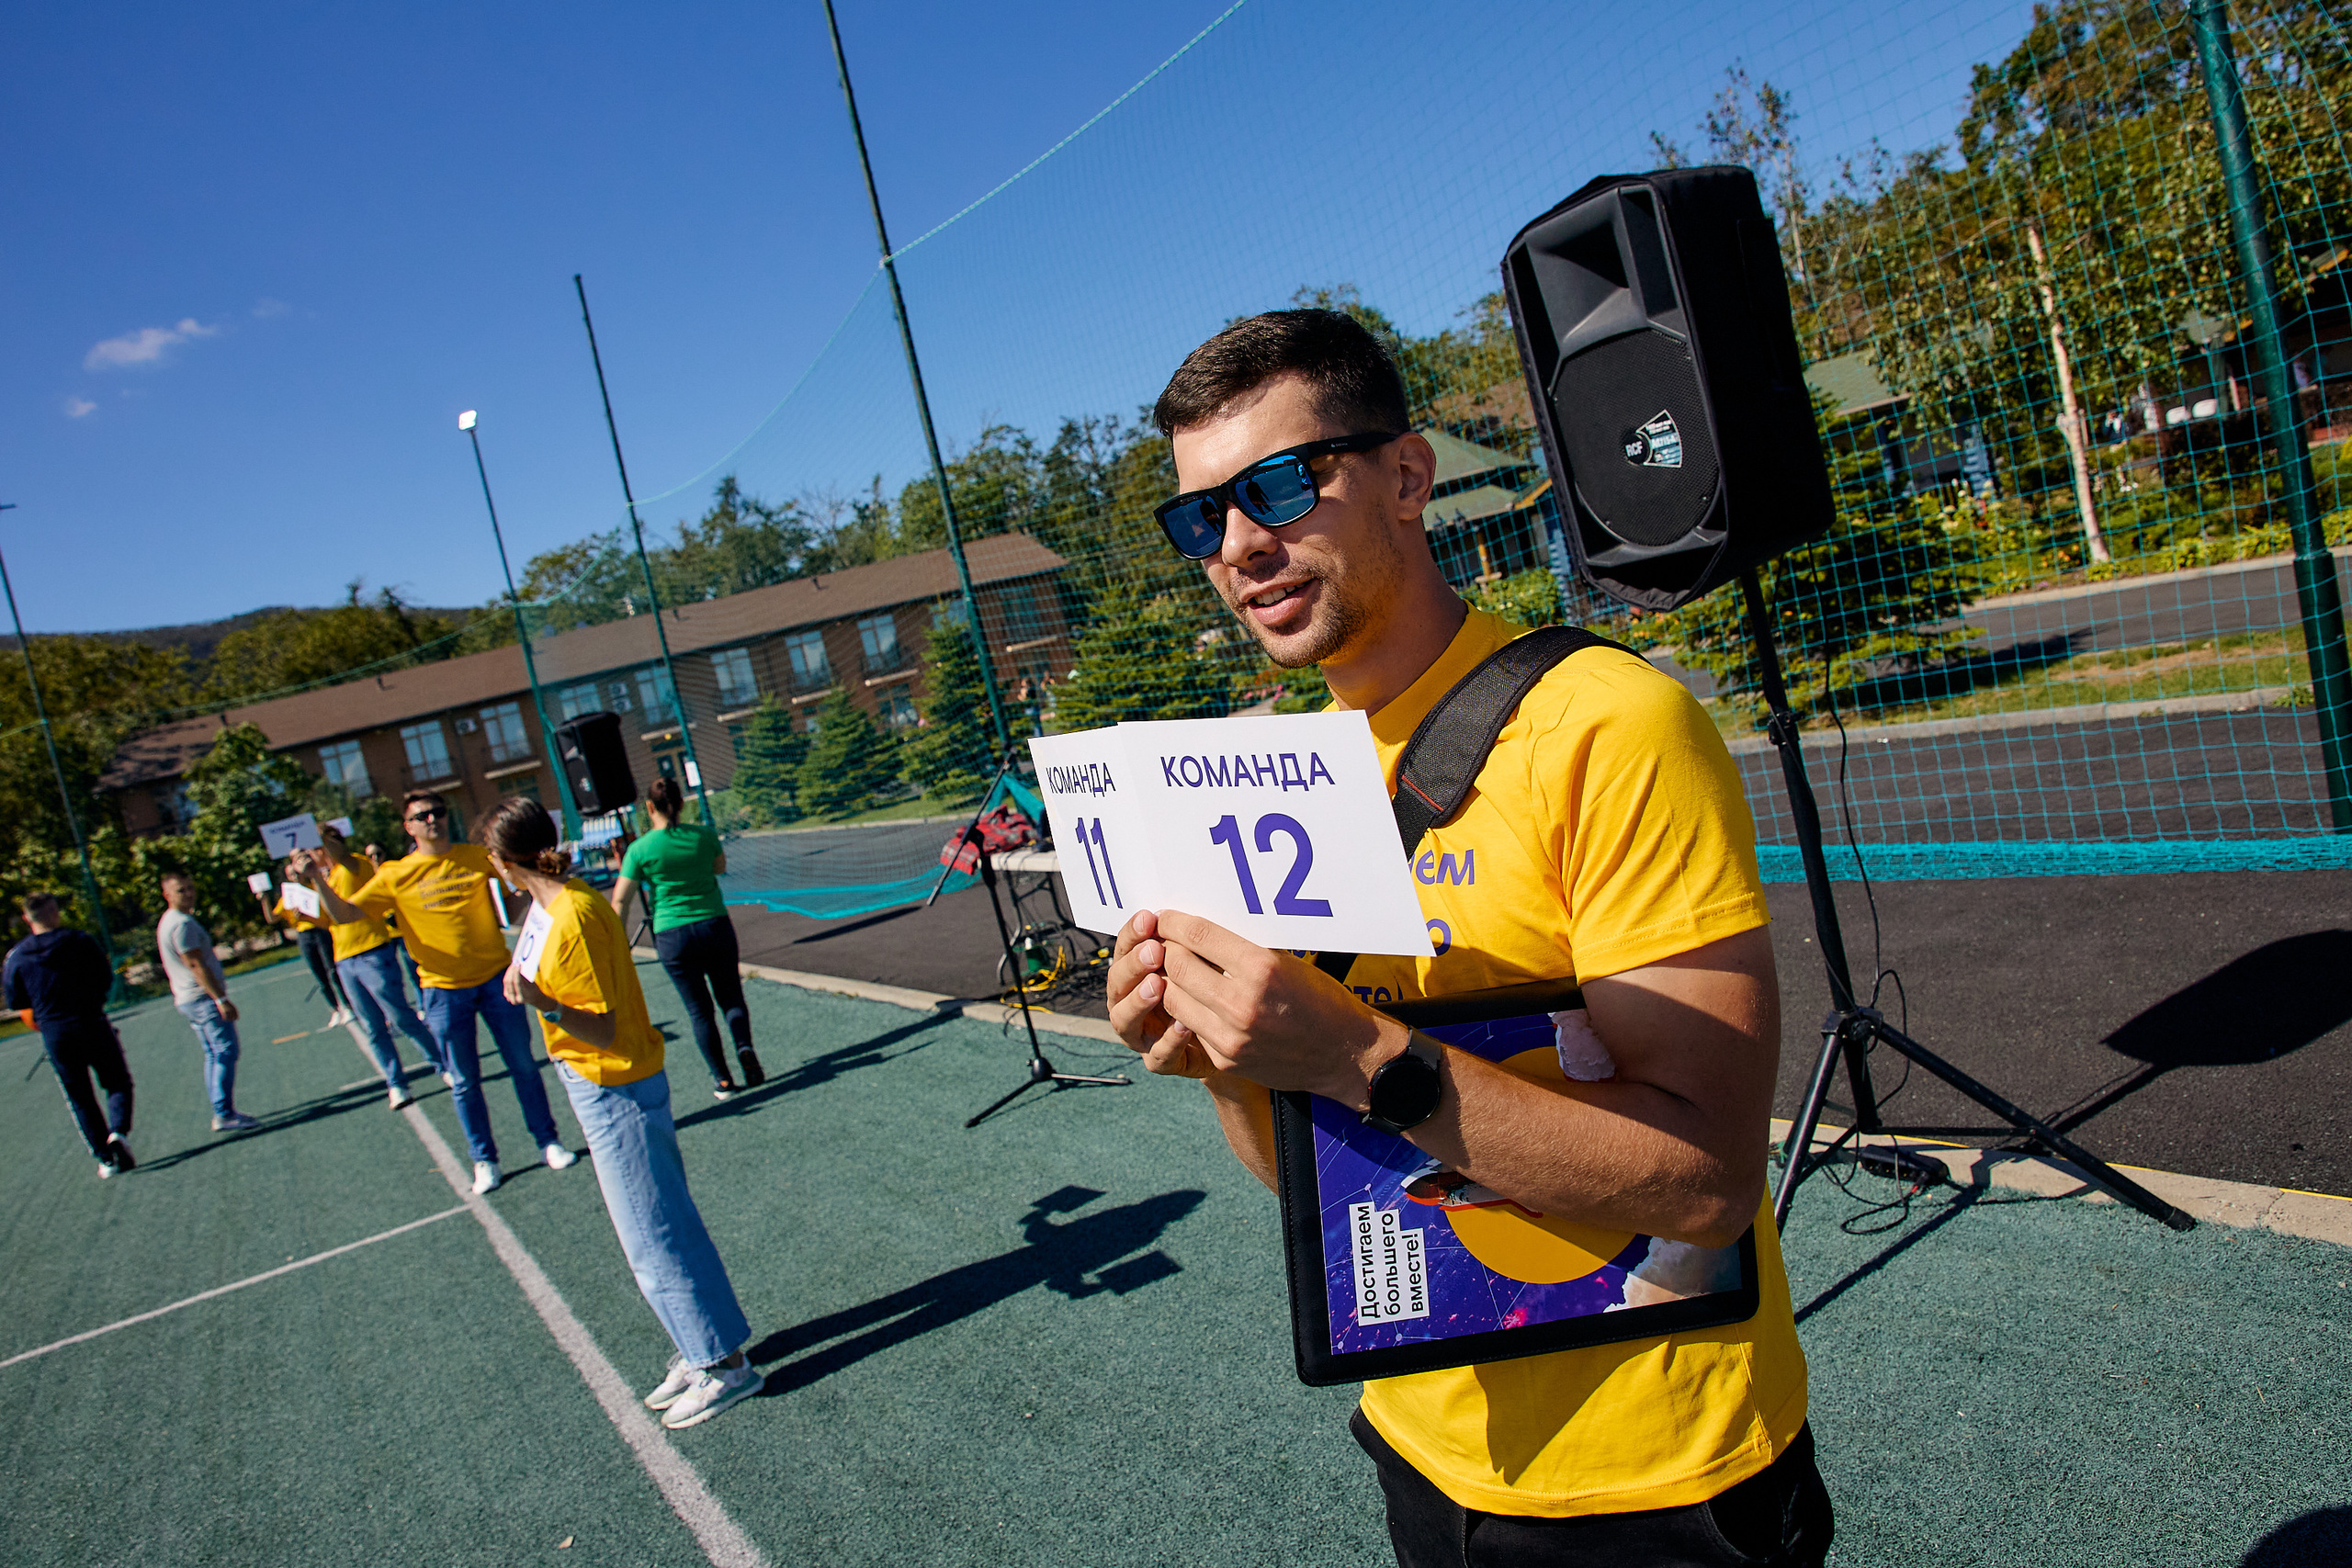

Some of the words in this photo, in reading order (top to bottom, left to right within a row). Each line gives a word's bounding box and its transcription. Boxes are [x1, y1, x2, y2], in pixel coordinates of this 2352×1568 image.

[1625, 441, 1644, 457] RCF
[1046, 762, 1116, 797] КОМАНДА
[1160, 752, 1335, 792] КОМАНДА
[285, 832, 298, 848] 7
[1075, 817, 1124, 908] 11
[1209, 813, 1333, 917] 12
[1358, 1205, 1381, 1318] Достигаем
[1382, 1213, 1401, 1315] большего
[1401, 1233, 1424, 1312] вместе!
